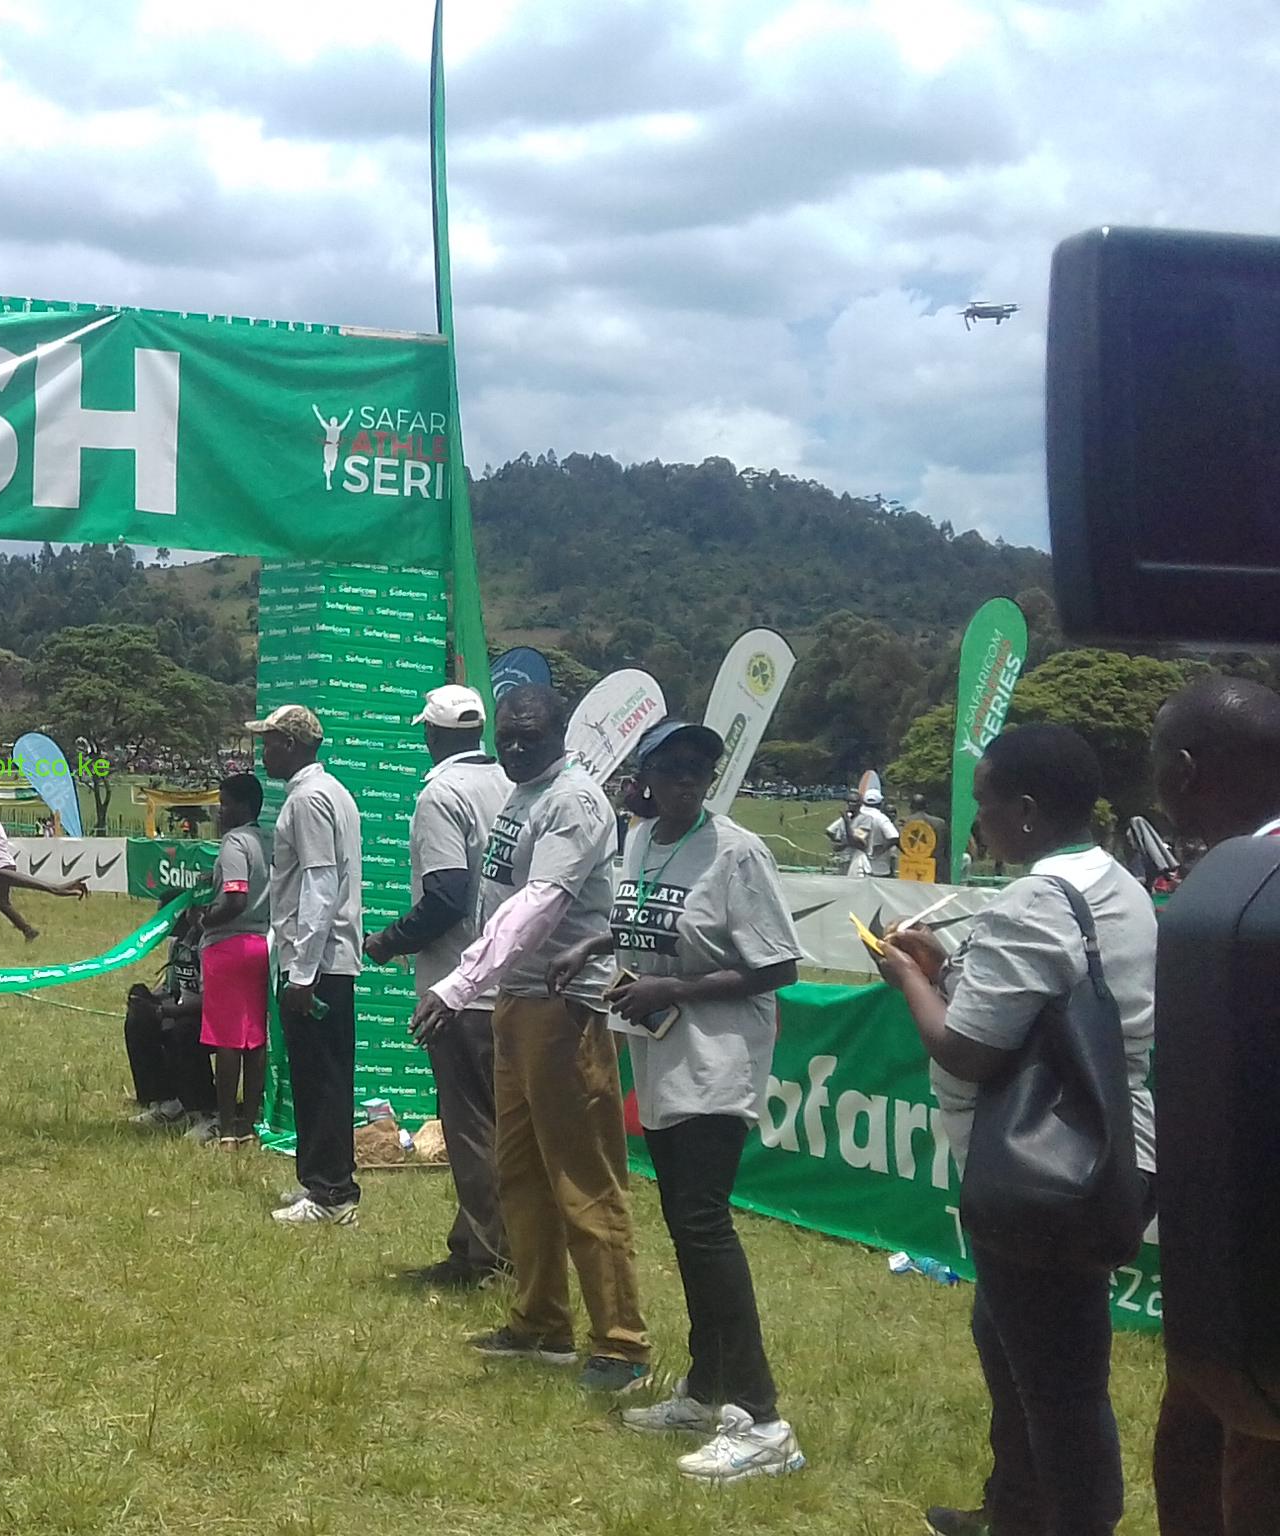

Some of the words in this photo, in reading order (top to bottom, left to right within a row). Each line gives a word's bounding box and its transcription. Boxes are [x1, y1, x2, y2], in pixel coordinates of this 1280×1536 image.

[360, 405, 446, 435] SAFAR
[351, 430, 449, 463] ATHLE
[342, 455, 445, 500] SERI
[965, 628, 1004, 728] SAFARICOM
[617, 697, 657, 738] KENYA
